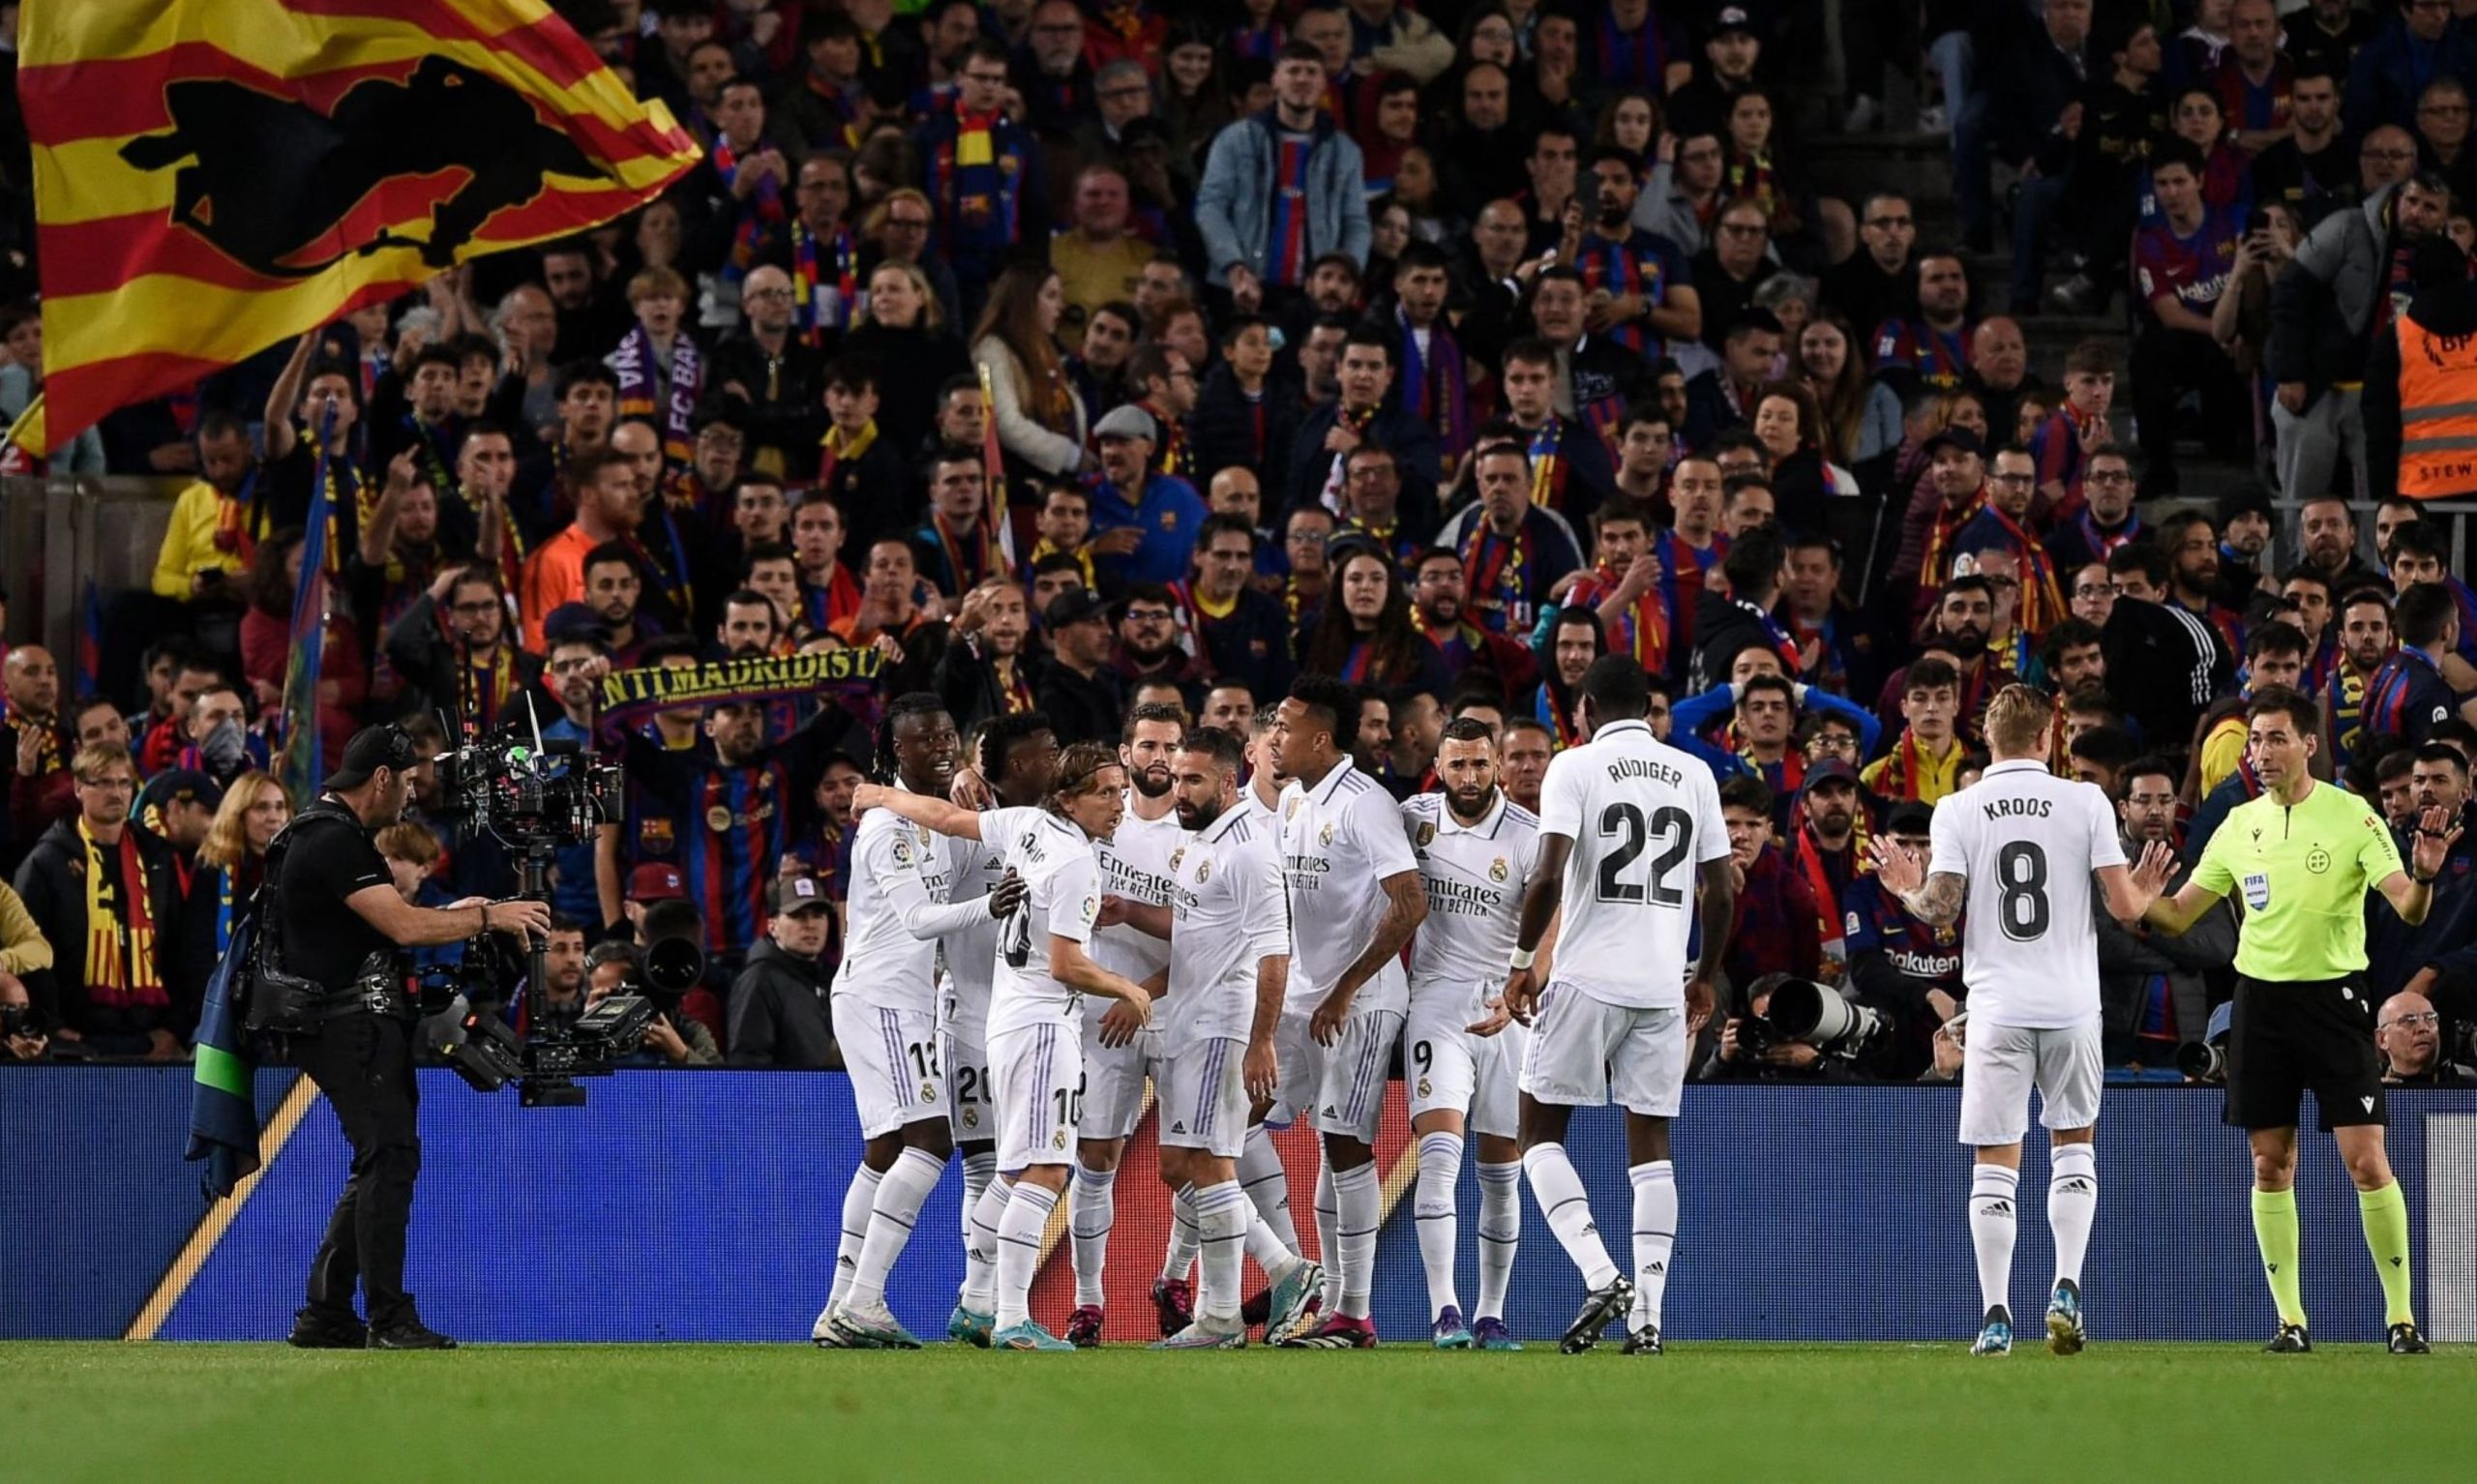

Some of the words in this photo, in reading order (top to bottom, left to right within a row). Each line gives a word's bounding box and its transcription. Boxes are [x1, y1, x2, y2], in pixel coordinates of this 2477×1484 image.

[1607, 757, 1683, 789] RÜDIGER
[1984, 798, 2053, 821] KROOS
[1596, 802, 1693, 909] 22
[1994, 840, 2050, 943] 8
[2245, 876, 2265, 886] FIFA
[1447, 898, 1487, 917] BETTER
[1414, 1039, 1433, 1077] 9
